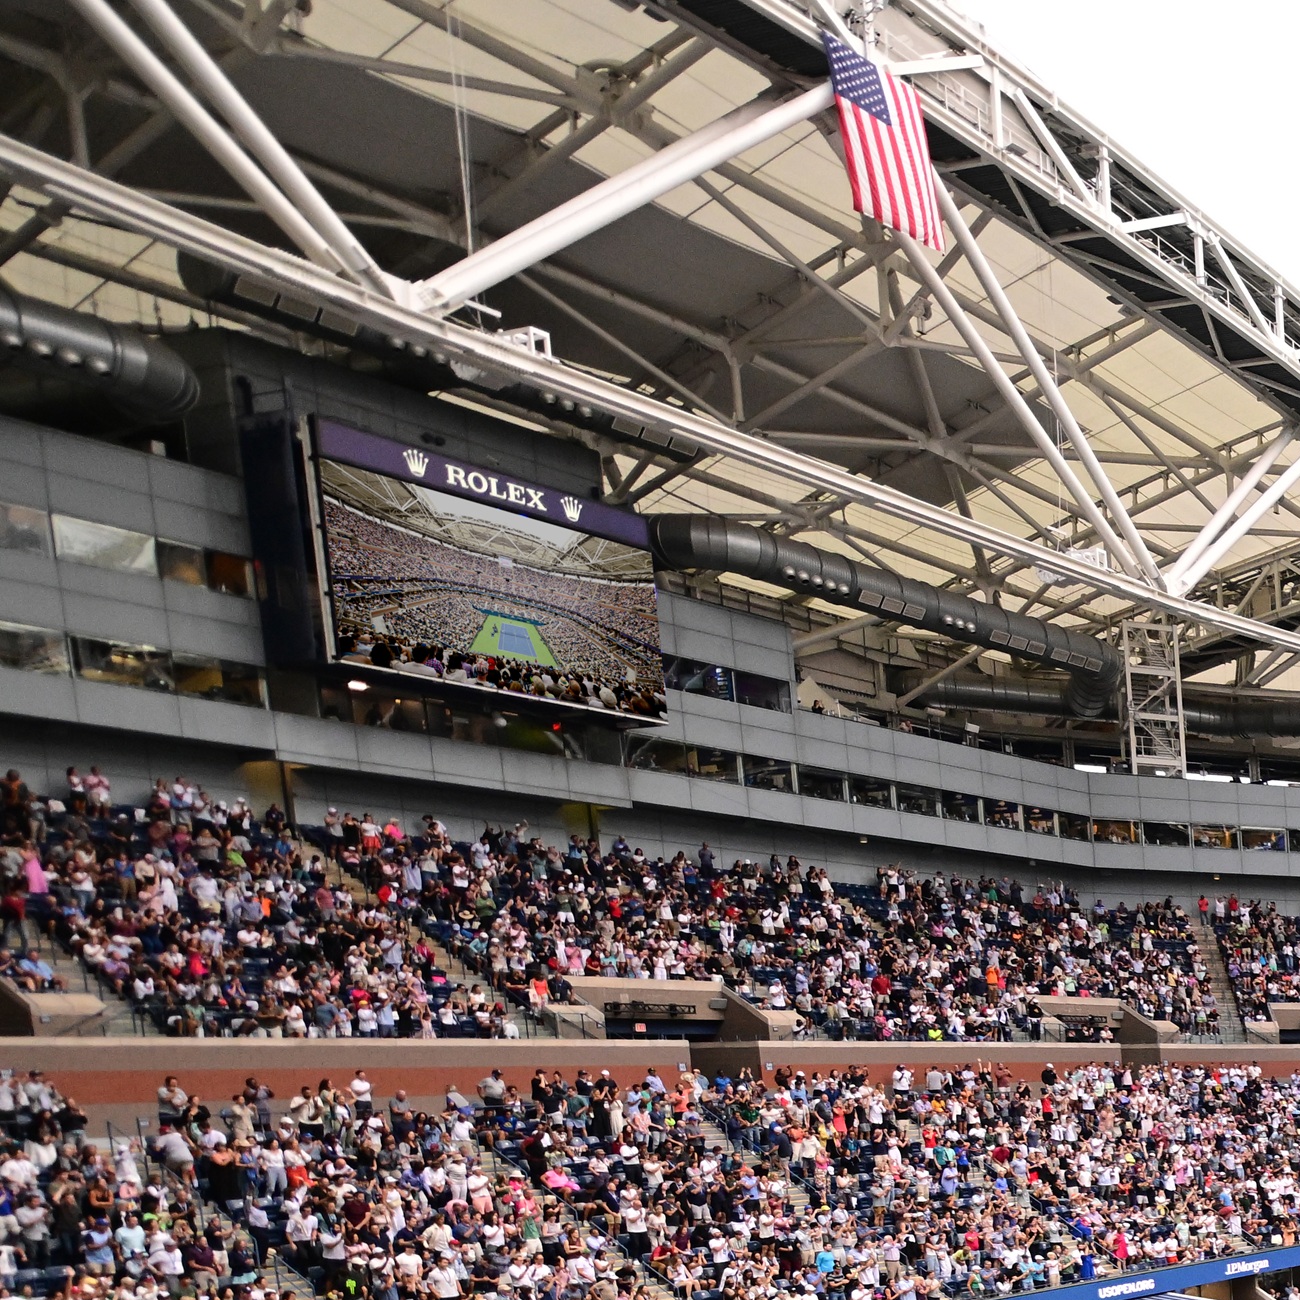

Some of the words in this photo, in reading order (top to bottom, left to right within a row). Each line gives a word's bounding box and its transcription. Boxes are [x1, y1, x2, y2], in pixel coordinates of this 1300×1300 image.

[445, 464, 547, 511] ROLEX
[1224, 1259, 1269, 1275] J.P.Morgan
[1097, 1278, 1155, 1299] USOPEN.ORG
